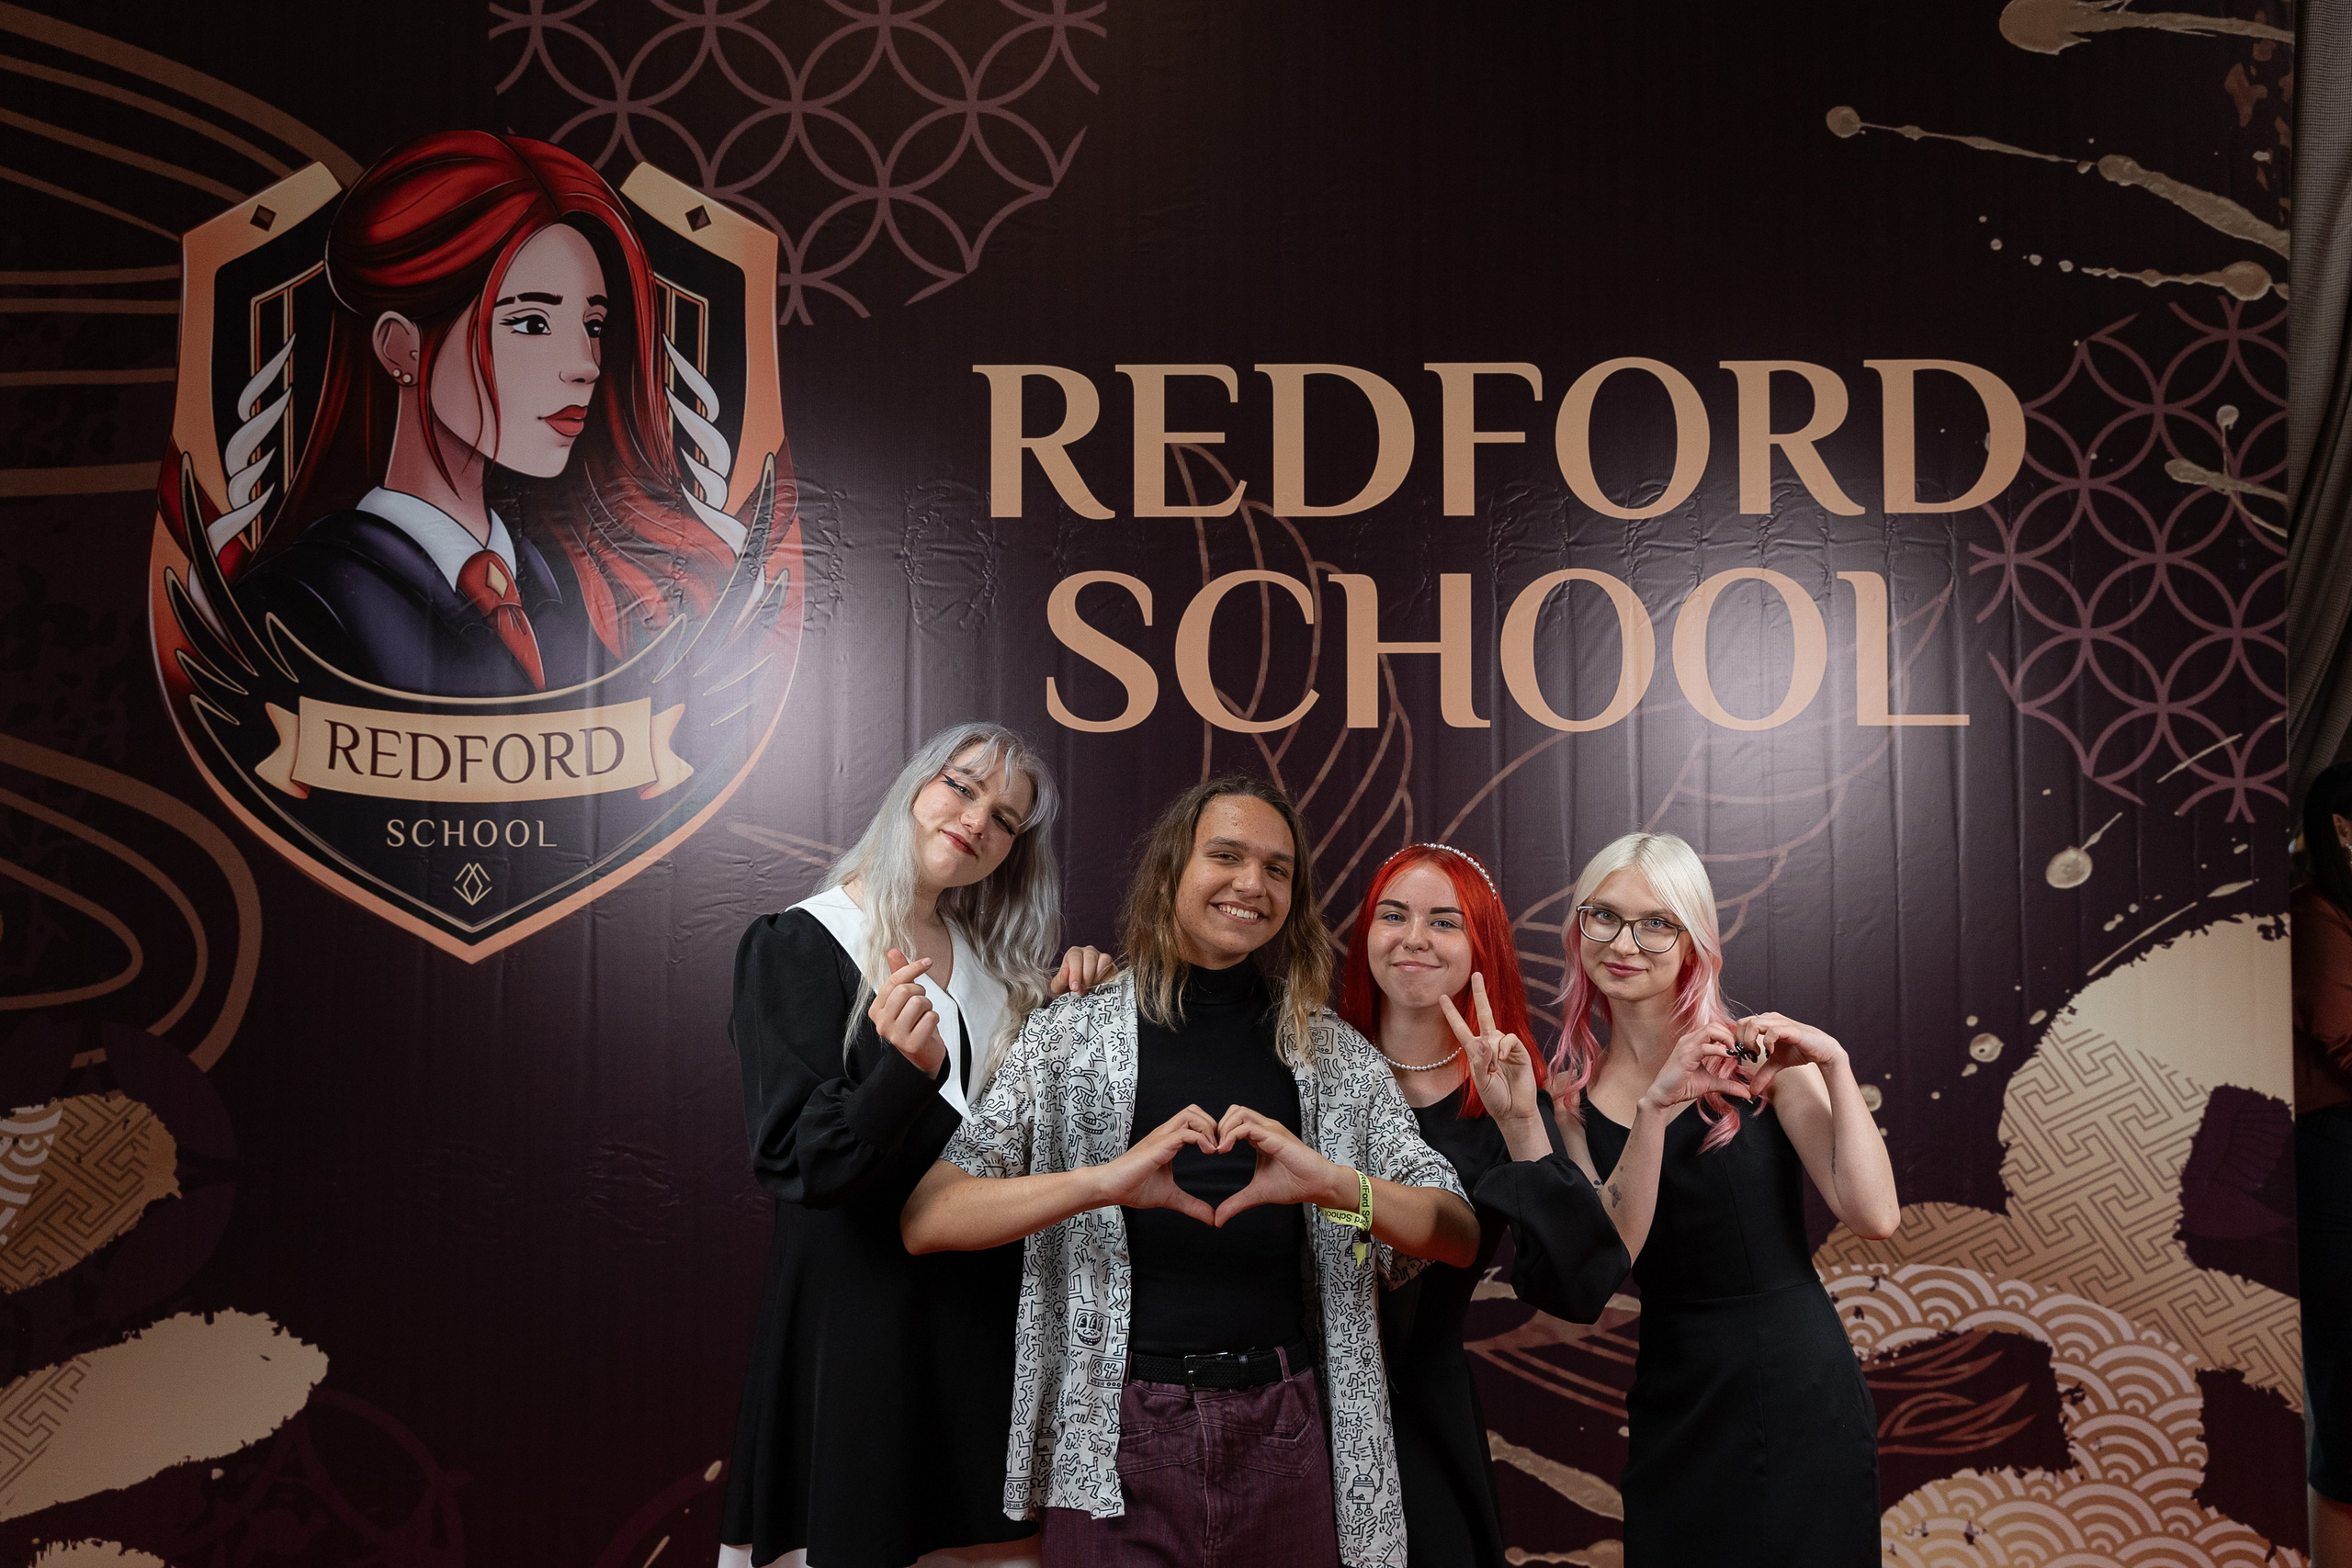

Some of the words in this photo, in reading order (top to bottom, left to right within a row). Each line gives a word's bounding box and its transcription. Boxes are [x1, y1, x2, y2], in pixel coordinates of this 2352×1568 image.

[972, 357, 2026, 520] REDFORD
[1046, 568, 1970, 734] SCHOOL
[323, 719, 625, 784] REDFORD
[386, 818, 558, 848] SCHOOL
[1092, 1361, 1119, 1379] 84
[1006, 1482, 1029, 1500] 84
